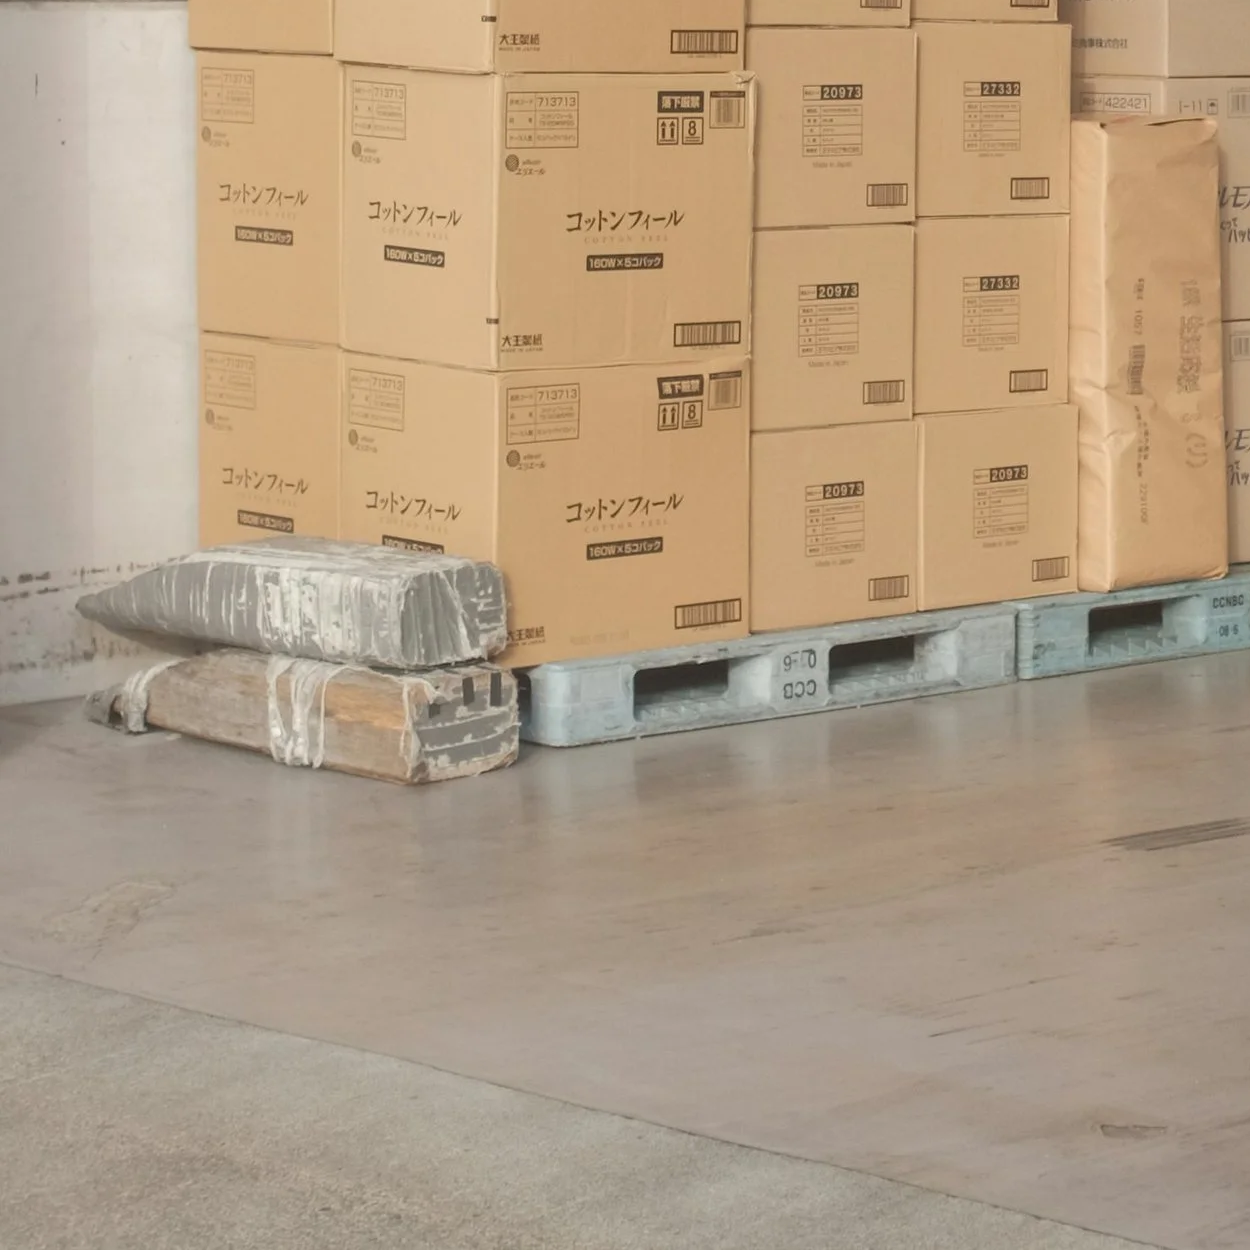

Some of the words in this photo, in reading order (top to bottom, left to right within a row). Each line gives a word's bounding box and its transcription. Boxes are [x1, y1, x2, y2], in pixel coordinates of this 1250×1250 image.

[822, 86, 862, 99] 20973
[982, 83, 1020, 96] 27332
[537, 96, 577, 107] 713713
[1105, 97, 1147, 110] 422421
[687, 120, 698, 137] 8
[218, 182, 309, 207] コットンフィール
[369, 199, 462, 228] コットンフィール
[565, 209, 686, 234] コットンフィール
[386, 248, 444, 266] 160W×5コパック
[588, 256, 662, 270] 160W×5コパック
[818, 283, 859, 299] 20973
[981, 276, 1020, 291] 27332
[537, 387, 578, 402] 713713
[687, 404, 698, 421] 8
[221, 466, 310, 496] コットンフィール
[990, 465, 1028, 482] 20973
[824, 481, 864, 499] 20973
[365, 489, 461, 521] コットンフィール
[565, 493, 684, 524] コットンフィール
[588, 541, 662, 560] 160W×5コパック
[783, 680, 816, 699] CCB
